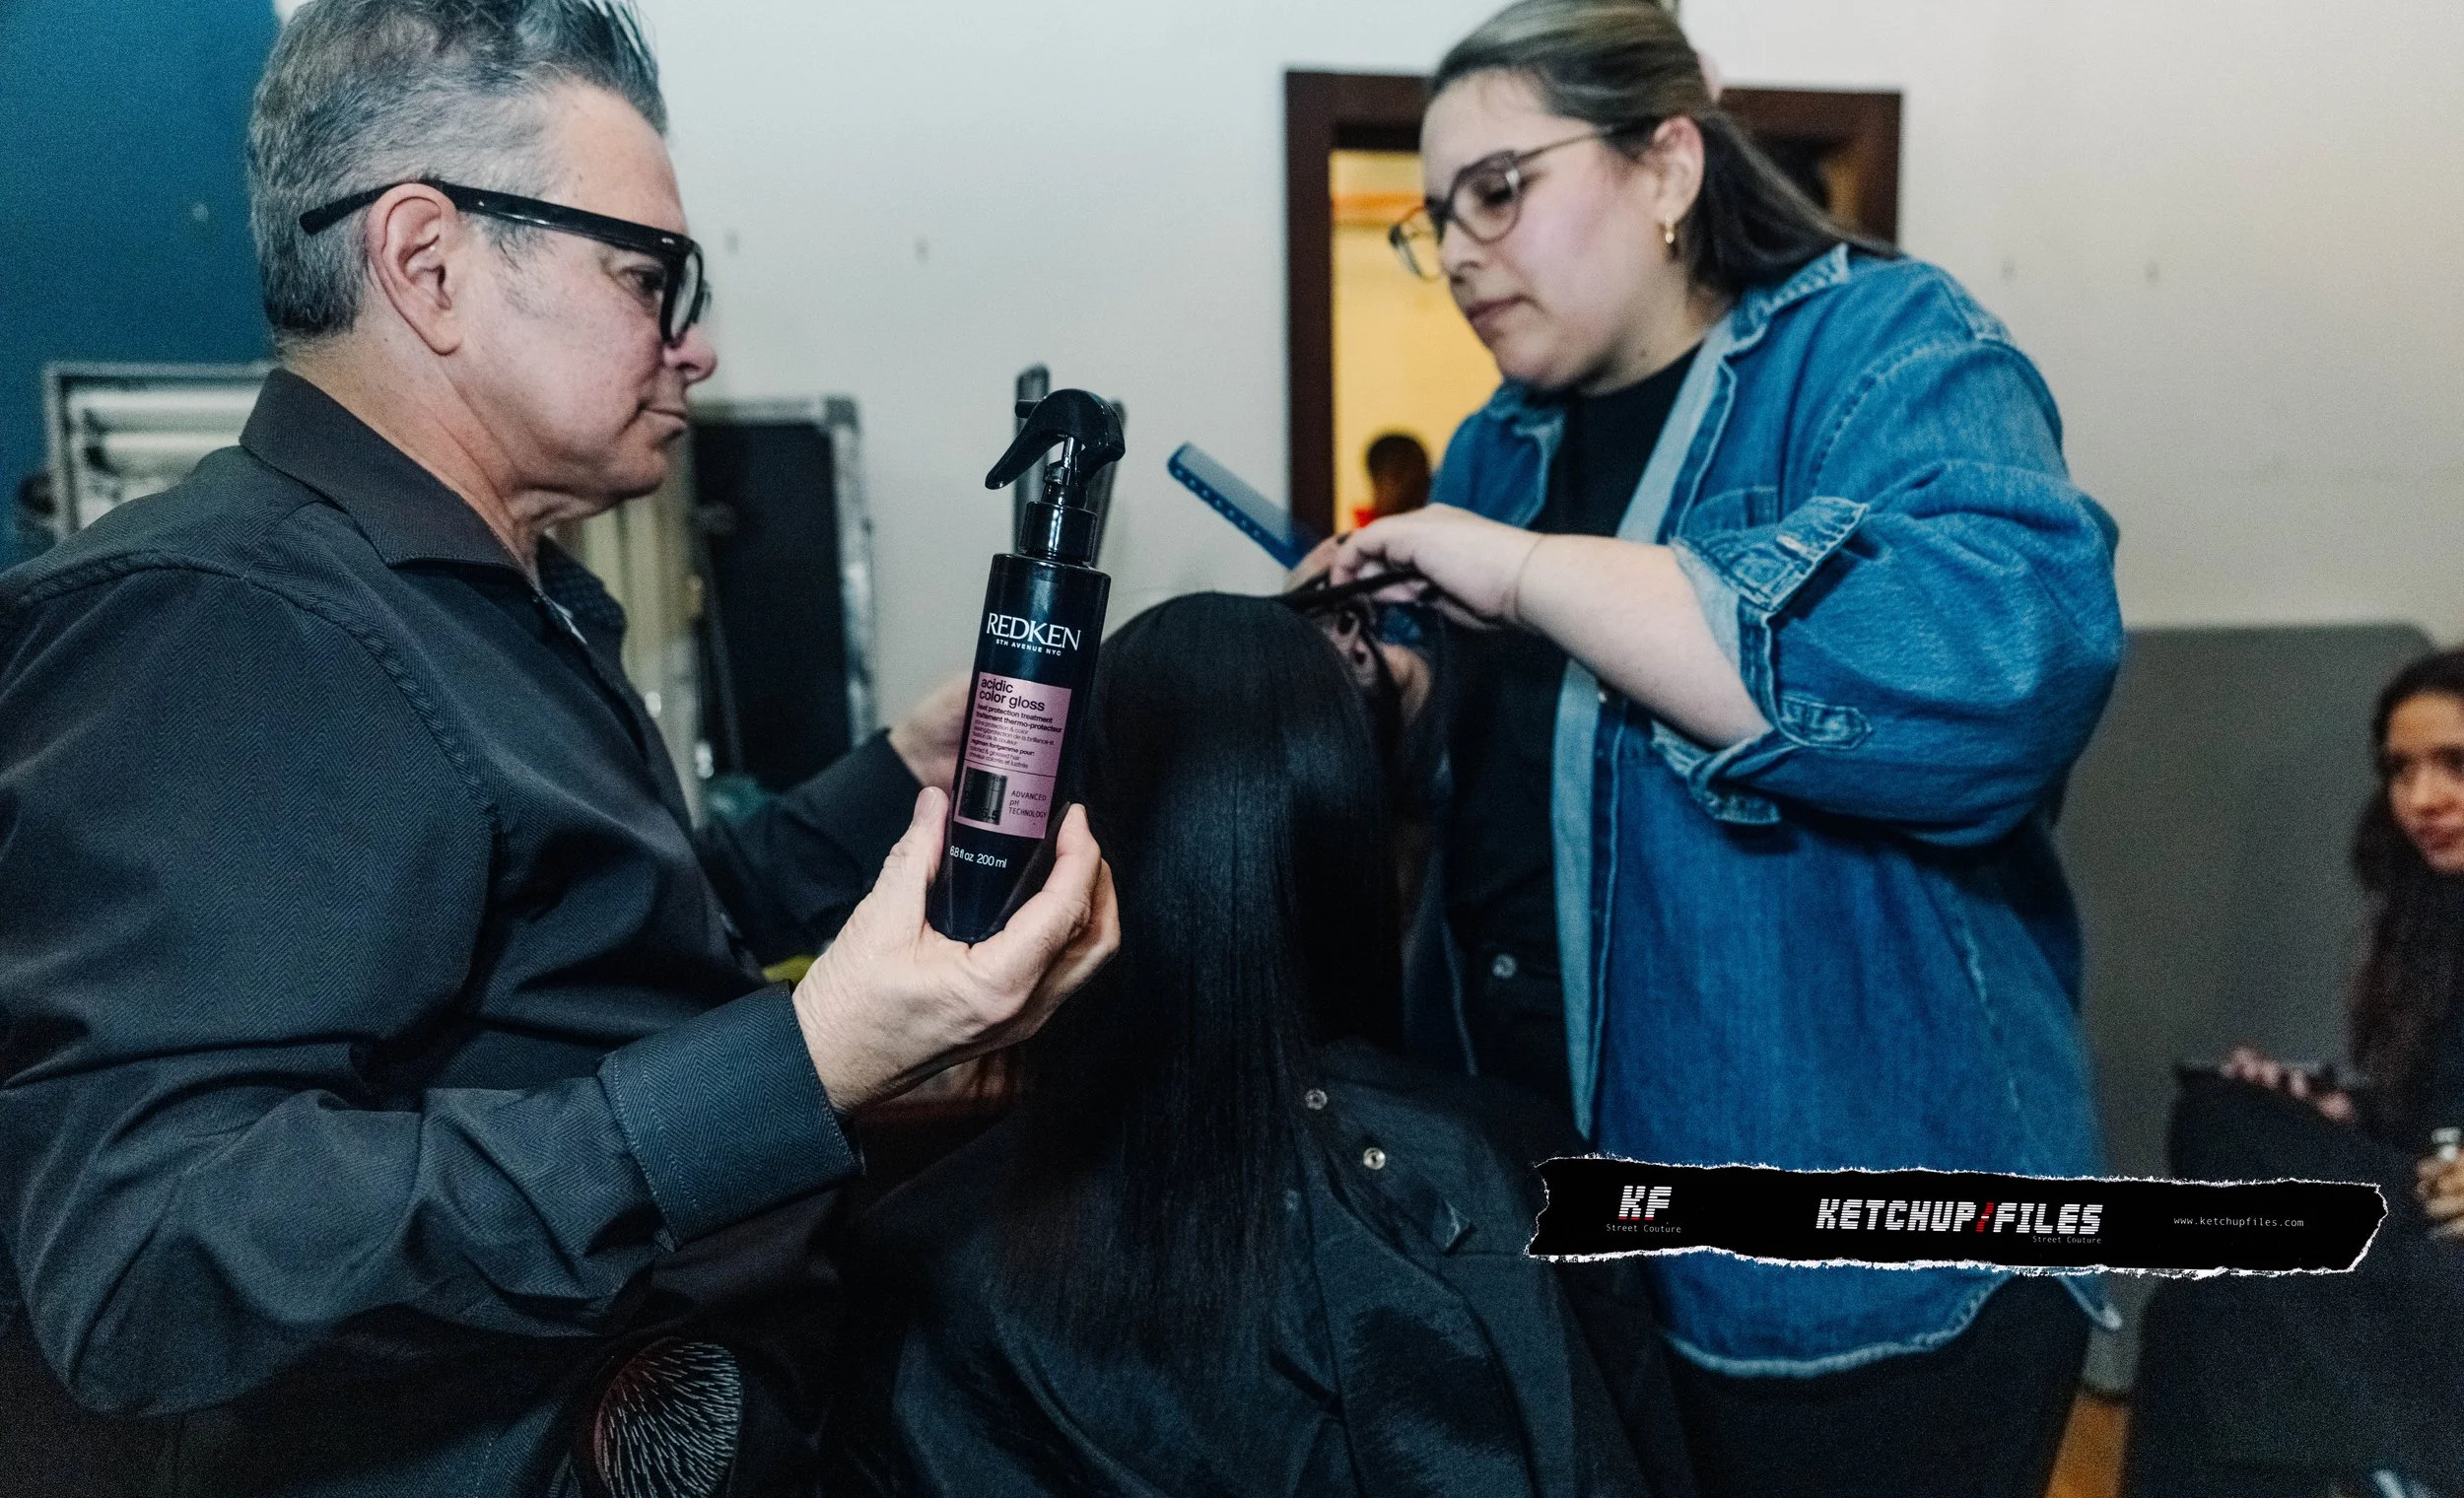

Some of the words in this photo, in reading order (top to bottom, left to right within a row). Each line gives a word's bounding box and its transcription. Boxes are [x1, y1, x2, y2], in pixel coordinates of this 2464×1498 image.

[987, 613, 1081, 650] REDKEN
[1011, 642, 1042, 653] AVENUE
[1046, 647, 1061, 656] NYC
[982, 678, 1013, 694] acidic
[979, 690, 1006, 704] color
[1009, 696, 1045, 712] gloss
[989, 707, 1019, 718] protection
[1021, 713, 1053, 723] treatment
[1004, 717, 1062, 733] thermo-protecteur
[1011, 790, 1047, 801] ADVANCED
[1009, 807, 1047, 818] TECHNOLOGY
[964, 852, 974, 862] oz
[977, 853, 994, 866] 200
[995, 858, 1007, 868] ml
